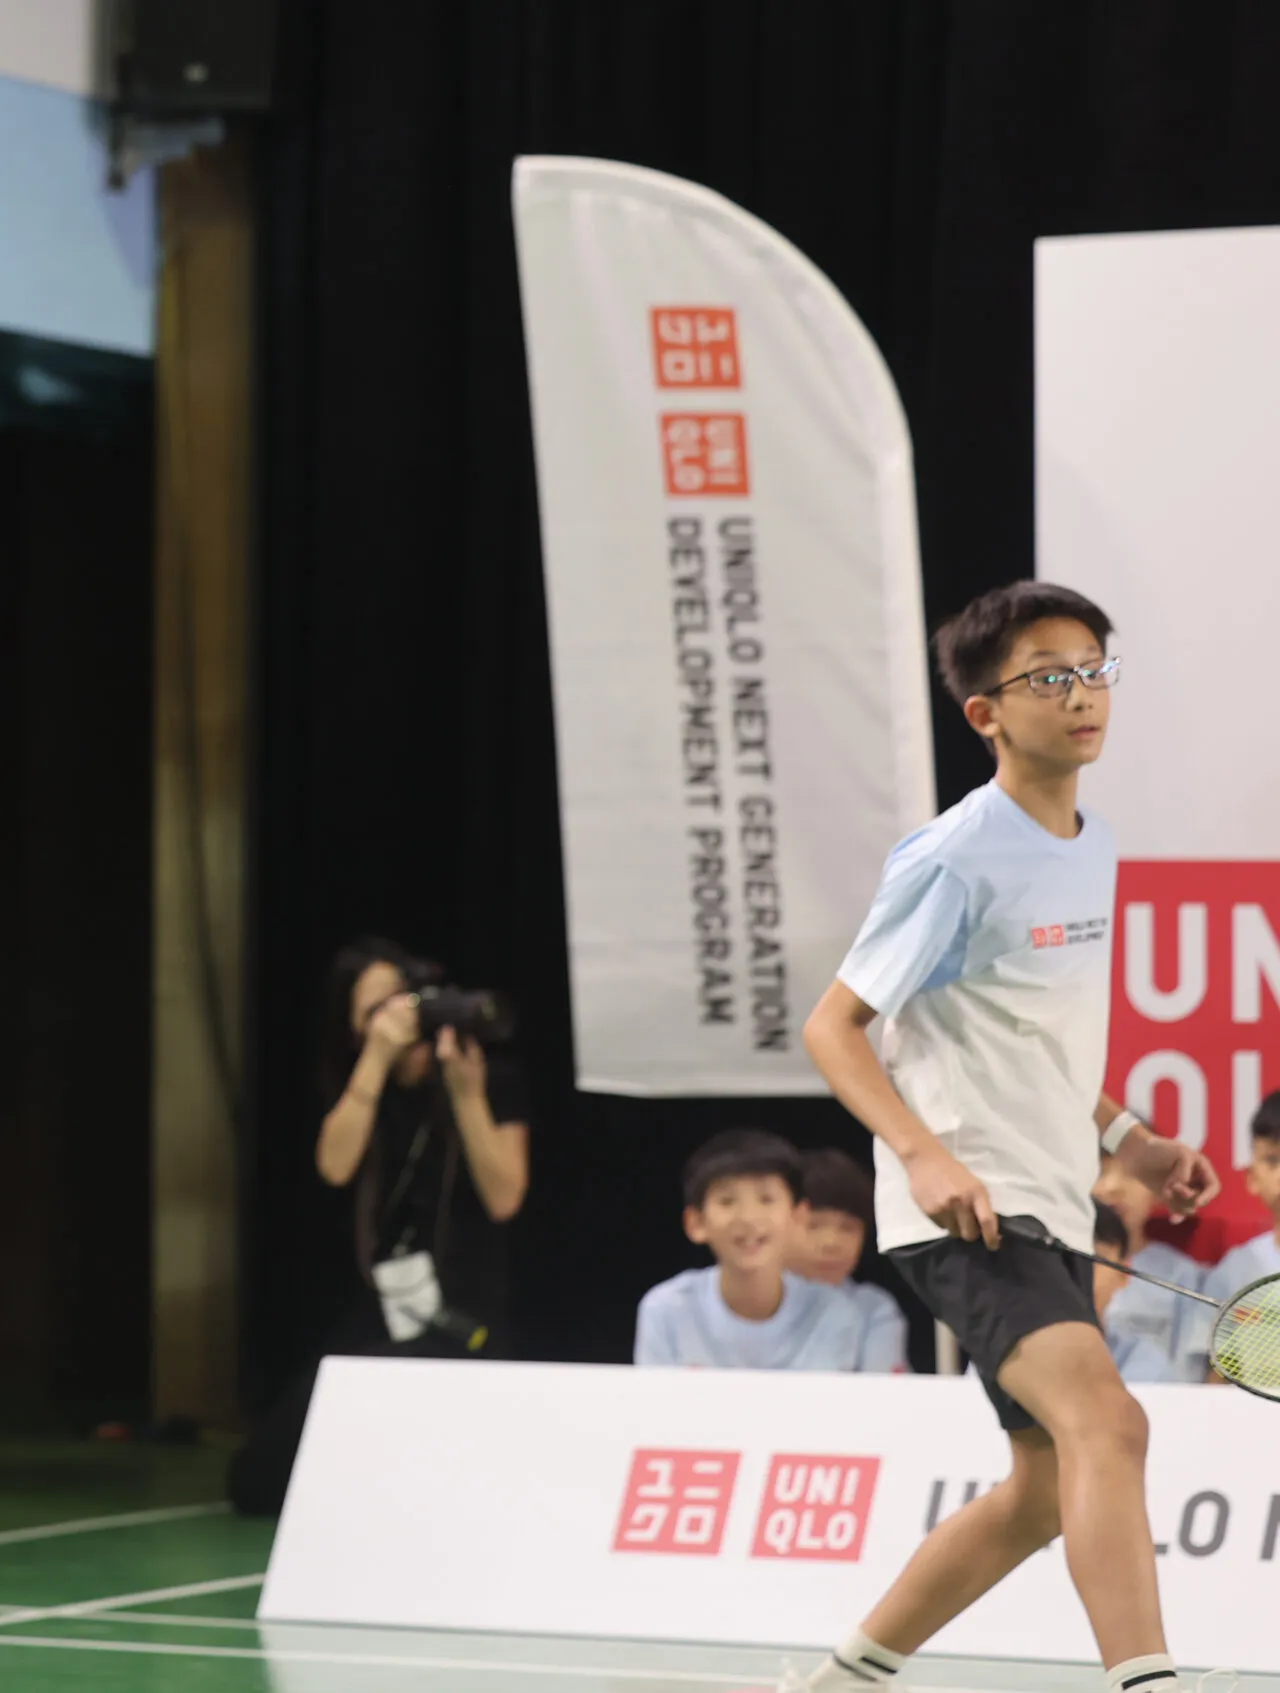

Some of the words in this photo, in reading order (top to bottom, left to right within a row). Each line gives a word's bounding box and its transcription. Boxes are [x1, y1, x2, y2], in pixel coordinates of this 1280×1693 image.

[718, 517, 764, 665] UNIQLO
[667, 517, 720, 809] DEVELOPMENT
[729, 677, 771, 780] NEXT
[688, 827, 735, 1025] PROGRAM
[738, 796, 789, 1052] GENERATION
[623, 1503, 718, 1545] クロ
[636, 1458, 724, 1499] ユニ
[774, 1463, 861, 1507] UNI
[763, 1507, 859, 1555] QLO
